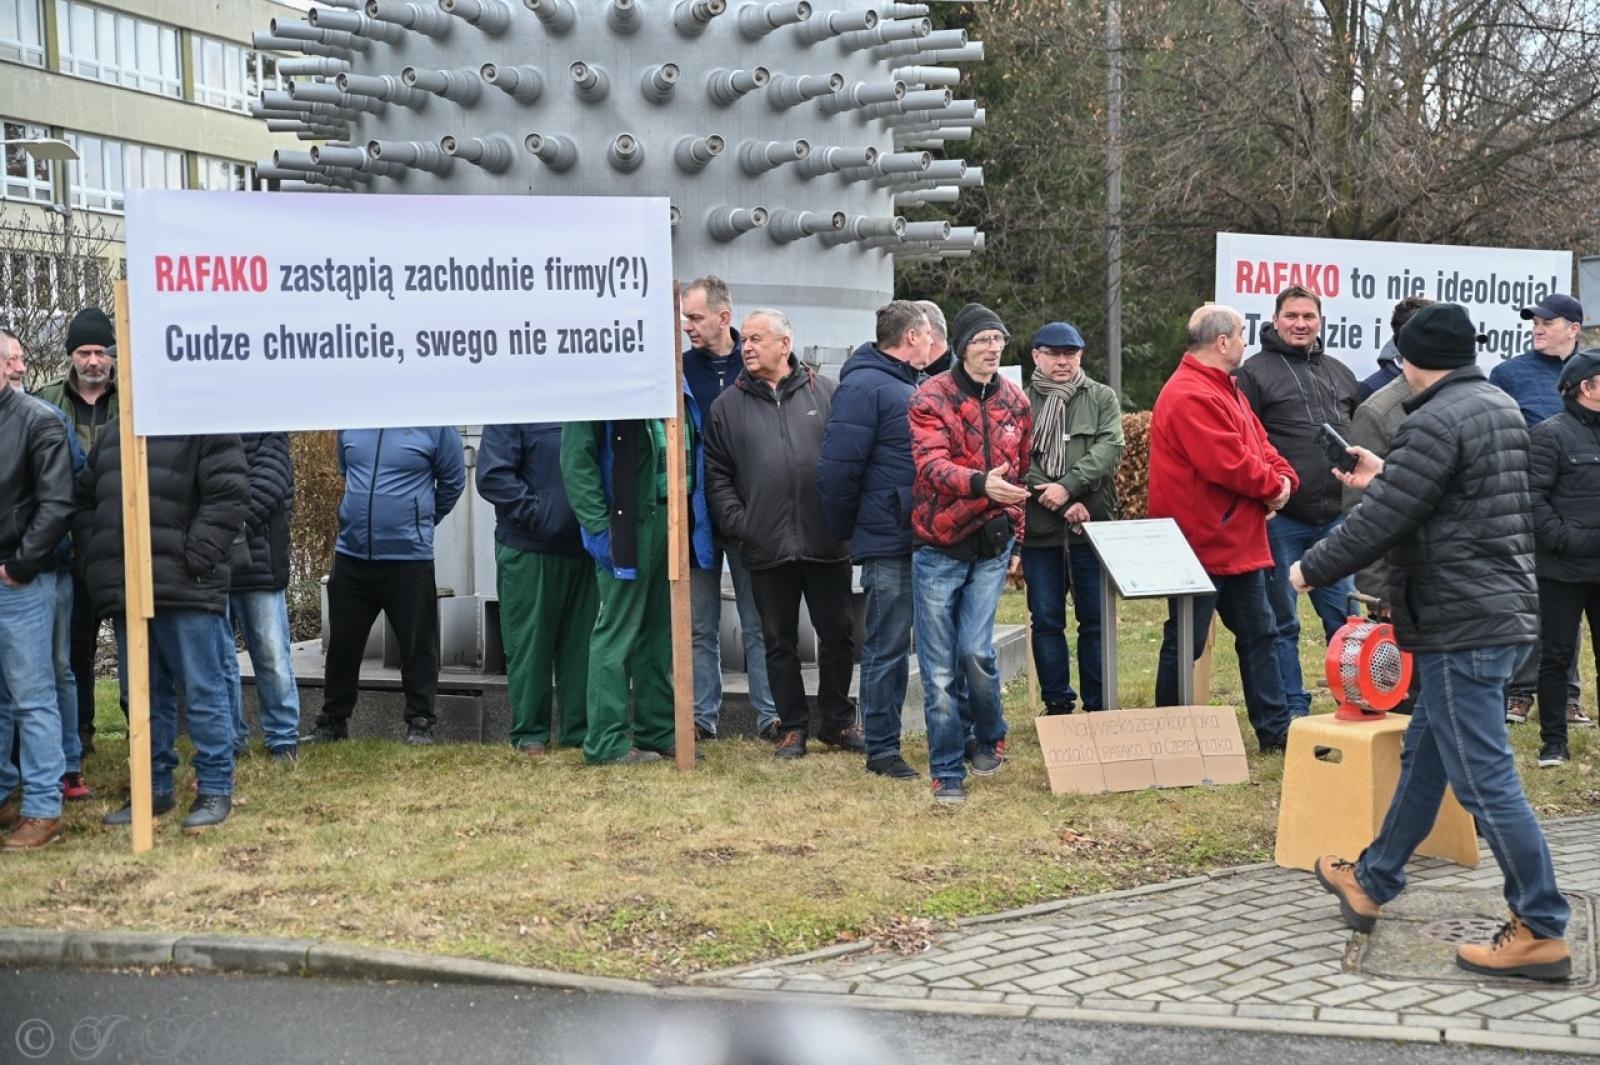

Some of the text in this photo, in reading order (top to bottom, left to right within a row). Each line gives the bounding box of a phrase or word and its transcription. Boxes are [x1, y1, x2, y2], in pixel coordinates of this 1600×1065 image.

[155, 255, 648, 300] RAFAKO zastąpią zachodnie firmy(?!)
[1235, 260, 1340, 298] RAFAKO
[1350, 267, 1376, 299] to
[1387, 268, 1426, 300] nie
[165, 319, 645, 364] Cudze chwalicie, swego nie znacie!
